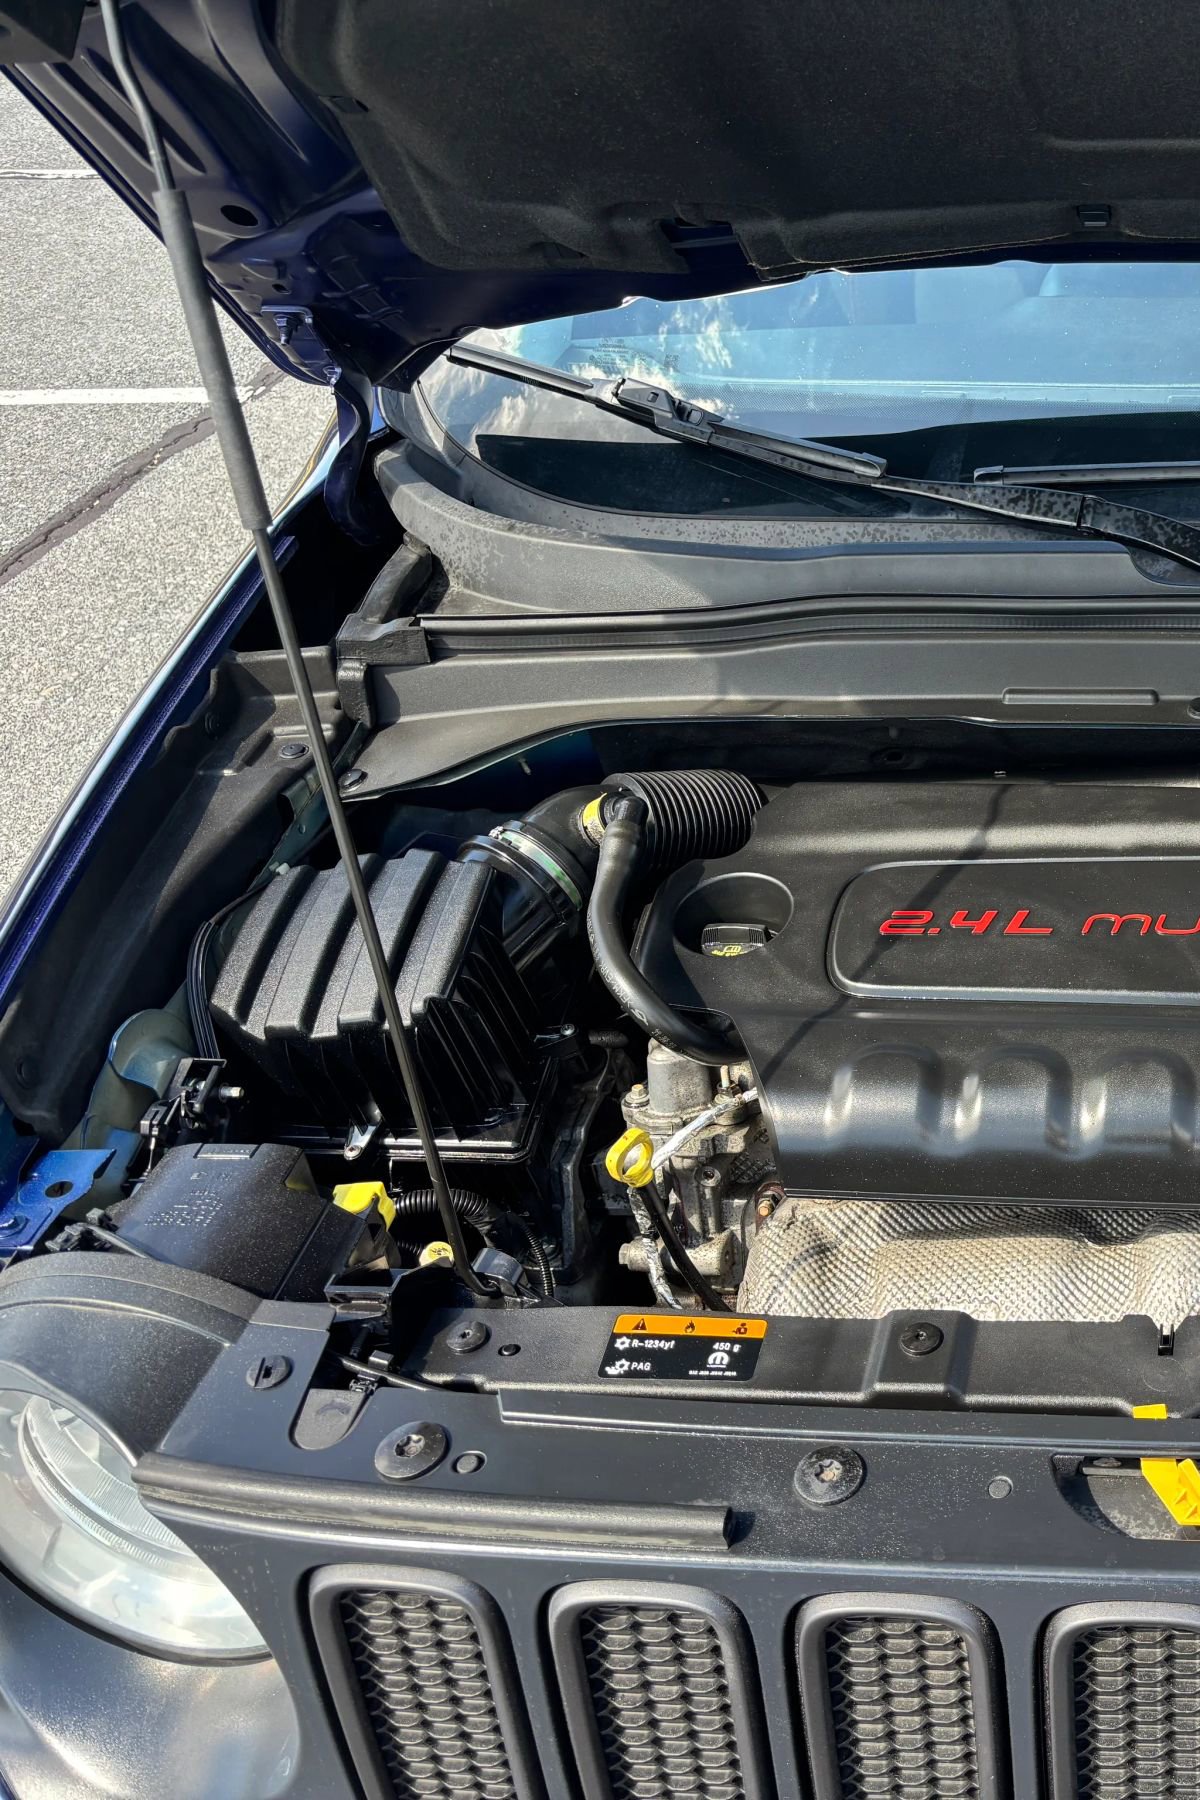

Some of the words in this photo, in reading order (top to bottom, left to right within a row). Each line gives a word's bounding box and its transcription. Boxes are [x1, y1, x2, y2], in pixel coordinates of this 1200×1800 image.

[631, 1339, 675, 1350] R-1234yf
[713, 1342, 731, 1351] 450
[631, 1363, 651, 1371] PAG
